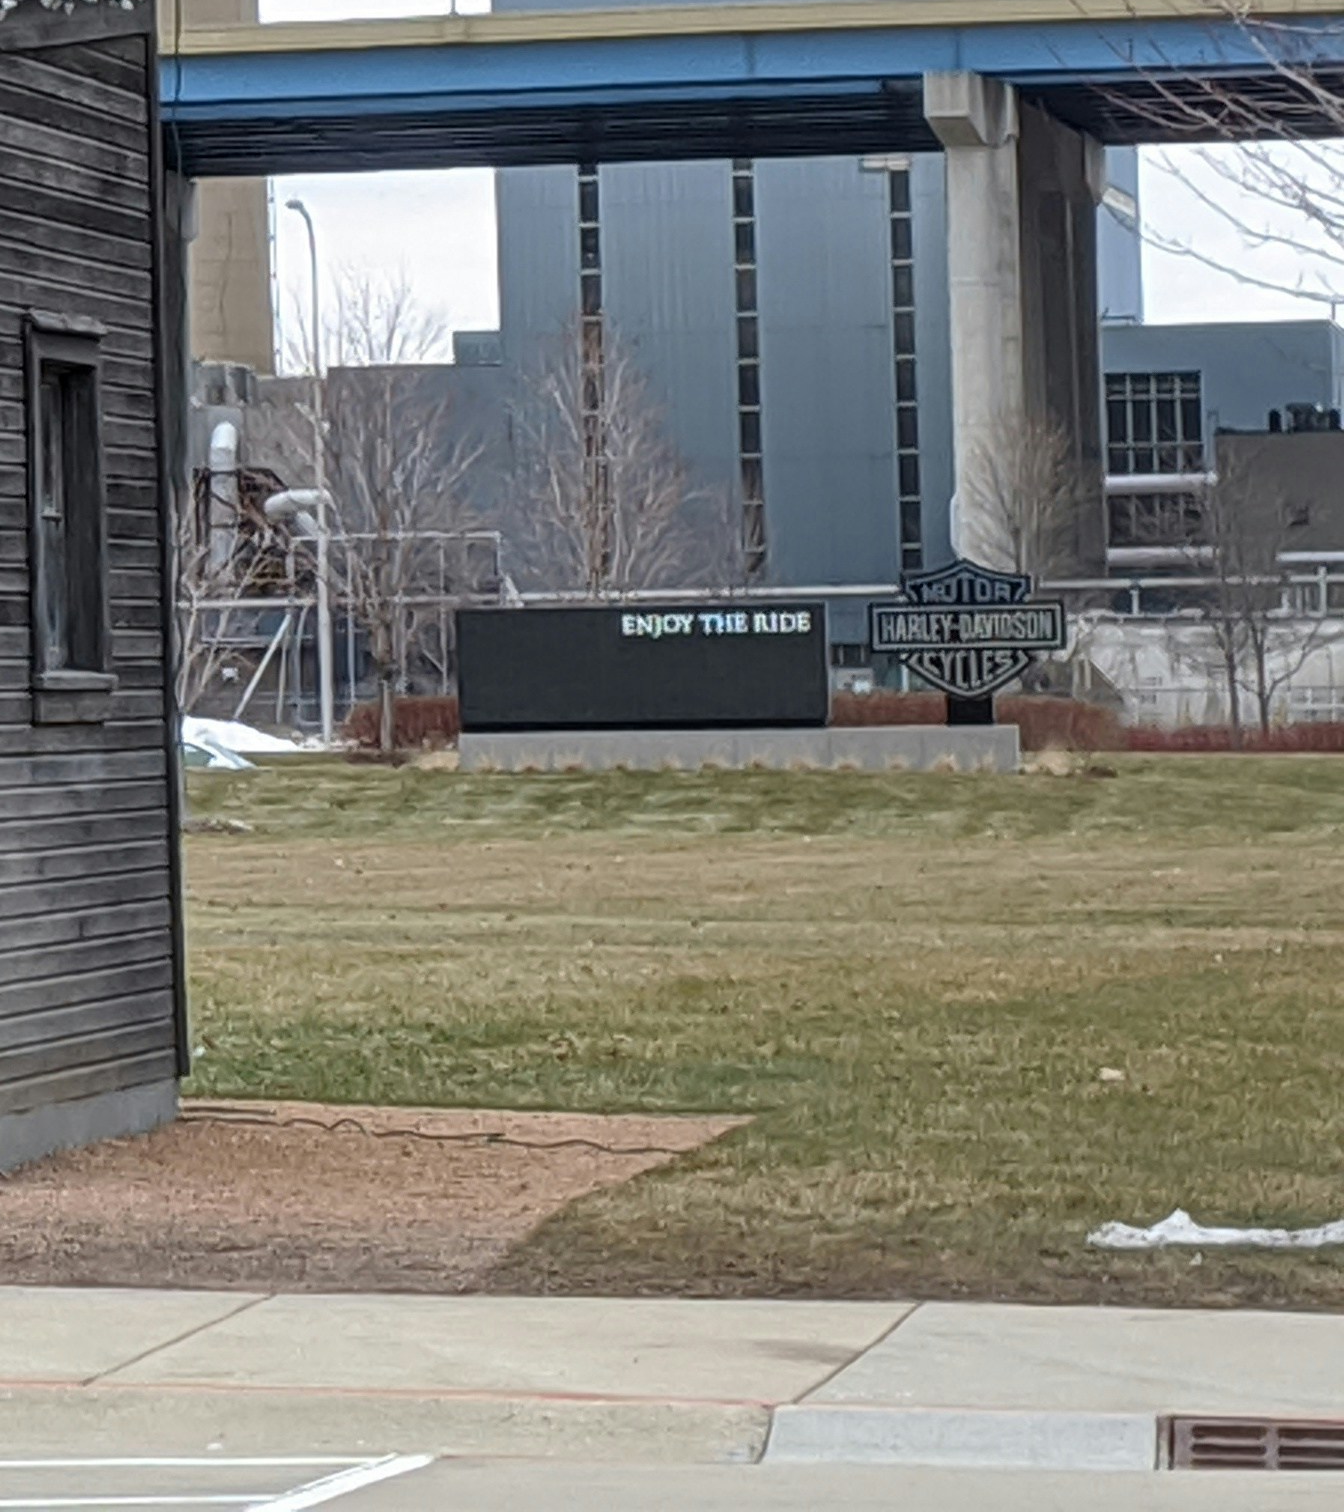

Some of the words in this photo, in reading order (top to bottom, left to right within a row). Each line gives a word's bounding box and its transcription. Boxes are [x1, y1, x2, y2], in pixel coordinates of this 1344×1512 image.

[921, 571, 1012, 603] MOTOR
[621, 612, 694, 638] ENJOY
[698, 611, 749, 635] THE
[753, 610, 812, 634] RIDE
[880, 610, 1053, 643] HARLEY-DAVIDSON
[923, 649, 1013, 689] CYCLES
